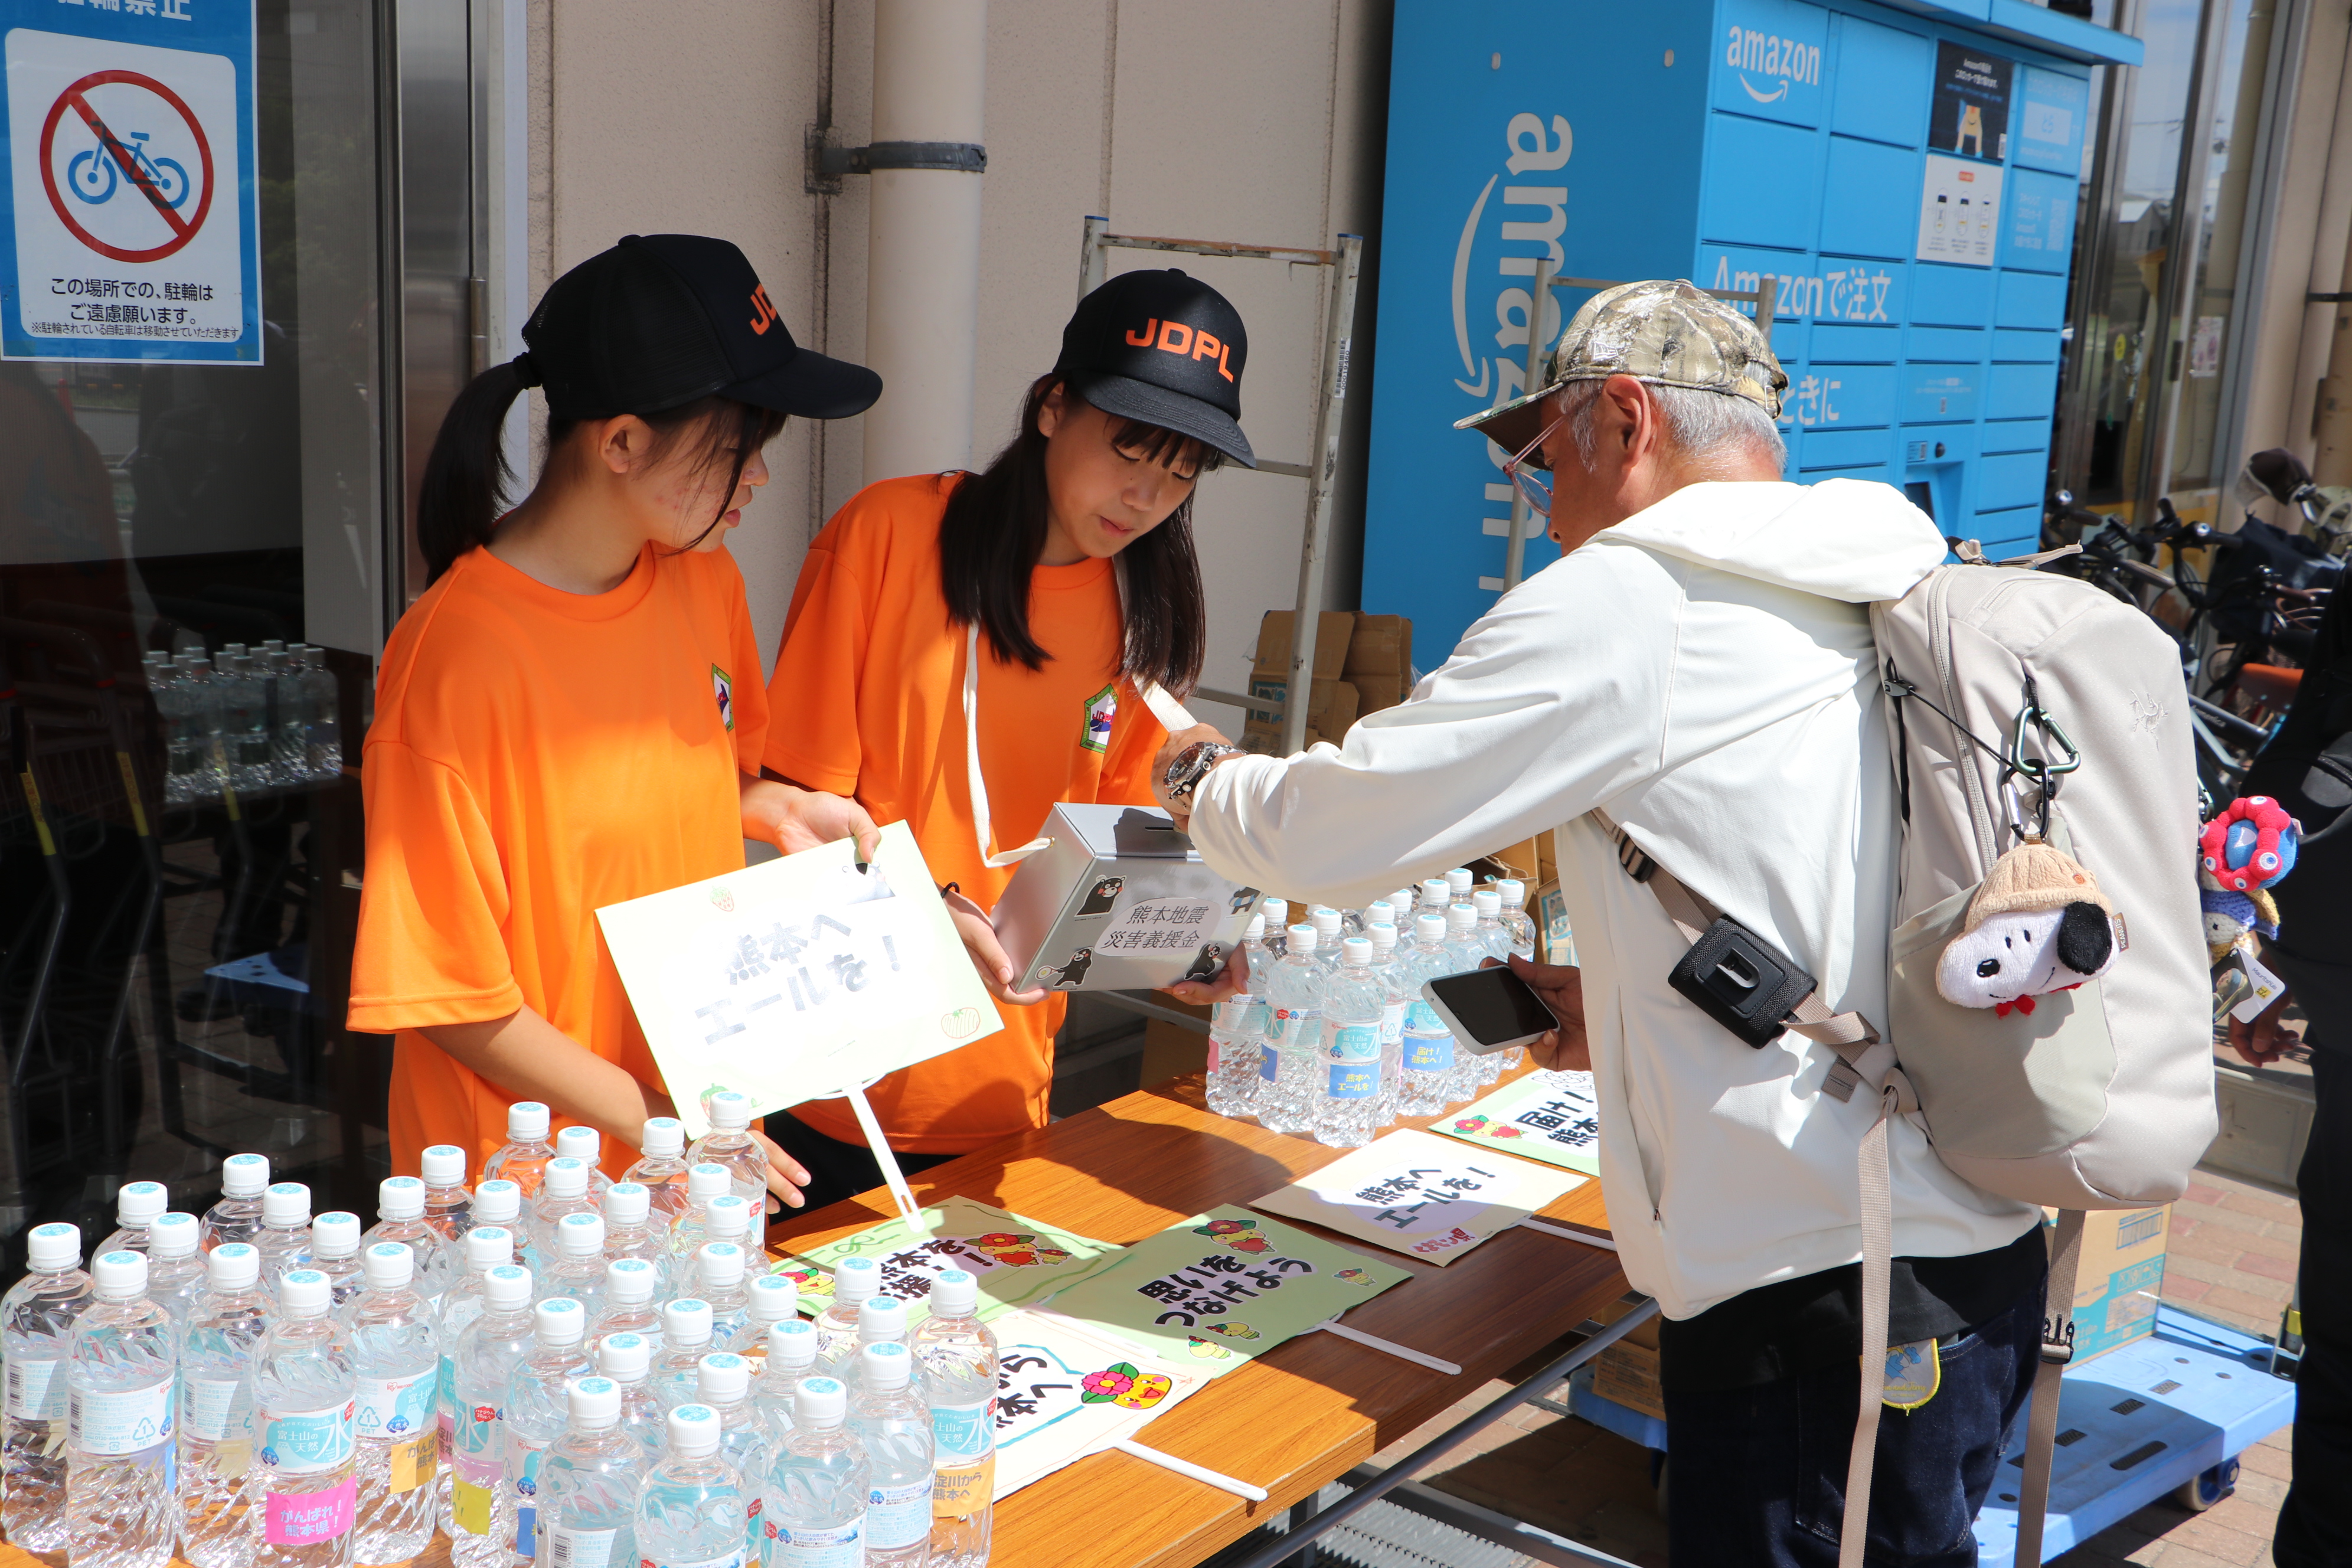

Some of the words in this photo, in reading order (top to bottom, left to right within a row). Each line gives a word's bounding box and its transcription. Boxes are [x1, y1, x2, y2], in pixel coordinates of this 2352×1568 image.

[1727, 25, 1820, 86] amazon
[51, 277, 214, 301] この場所での、駐輪は
[70, 303, 197, 324] ご遠慮願います。
[1126, 318, 1233, 383] JDPL
[1126, 906, 1209, 925] 熊本地震
[1100, 930, 1201, 949] 災害義援金
[2114, 919, 2126, 949] PEANUTS
[724, 914, 851, 985] 熊本へ
[2252, 968, 2277, 990] Mauritshuis
[694, 935, 901, 1046] エールを！
[1412, 1055, 1443, 1065] 熊本へ！
[1417, 1046, 1440, 1056] 届け！
[1346, 1073, 1370, 1082] 熊本へ
[1514, 1091, 1594, 1131] 届け！
[1355, 1168, 1443, 1205] 熊本へ
[1373, 1167, 1496, 1229] エールを！
[1137, 1254, 1247, 1304] 思いを
[1154, 1257, 1312, 1327] つなげよう
[579, 1380, 610, 1390] 天然水
[277, 1430, 318, 1440] 富士山の
[388, 1421, 409, 1430] 天然水
[957, 1407, 992, 1453] 水
[138, 1439, 151, 1447] PET
[295, 1442, 319, 1452] 天然
[313, 1412, 352, 1462] 水
[942, 1433, 963, 1443] 天然
[262, 1453, 278, 1463] 天然水
[518, 1484, 537, 1493] 天然水
[934, 1472, 982, 1488] 淀川から
[932, 1488, 971, 1501] 熊本へ
[280, 1500, 341, 1523] がんばれ！
[285, 1515, 338, 1537] 熊本県！
